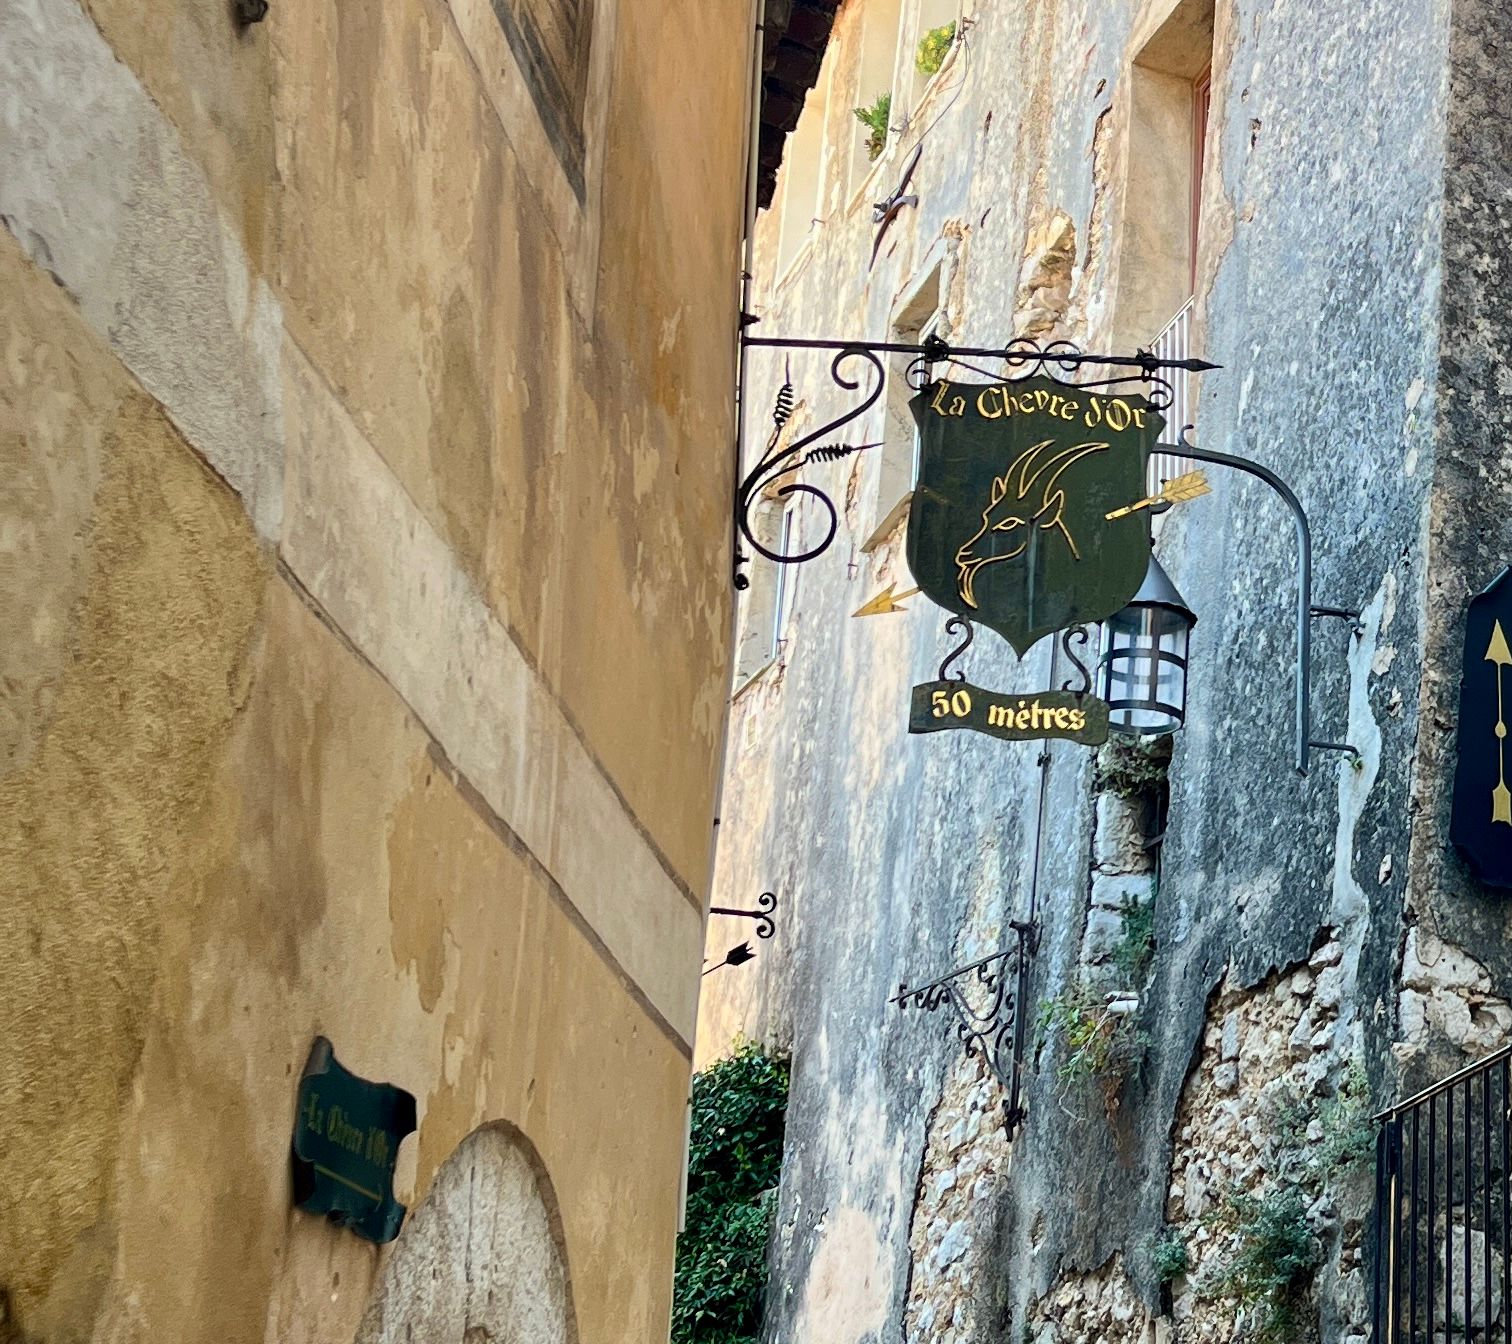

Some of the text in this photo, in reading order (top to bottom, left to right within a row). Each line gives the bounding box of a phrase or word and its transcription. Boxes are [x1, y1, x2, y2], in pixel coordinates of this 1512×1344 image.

[931, 381, 966, 416] La
[1085, 397, 1147, 432] d'Or
[931, 690, 972, 718] 50
